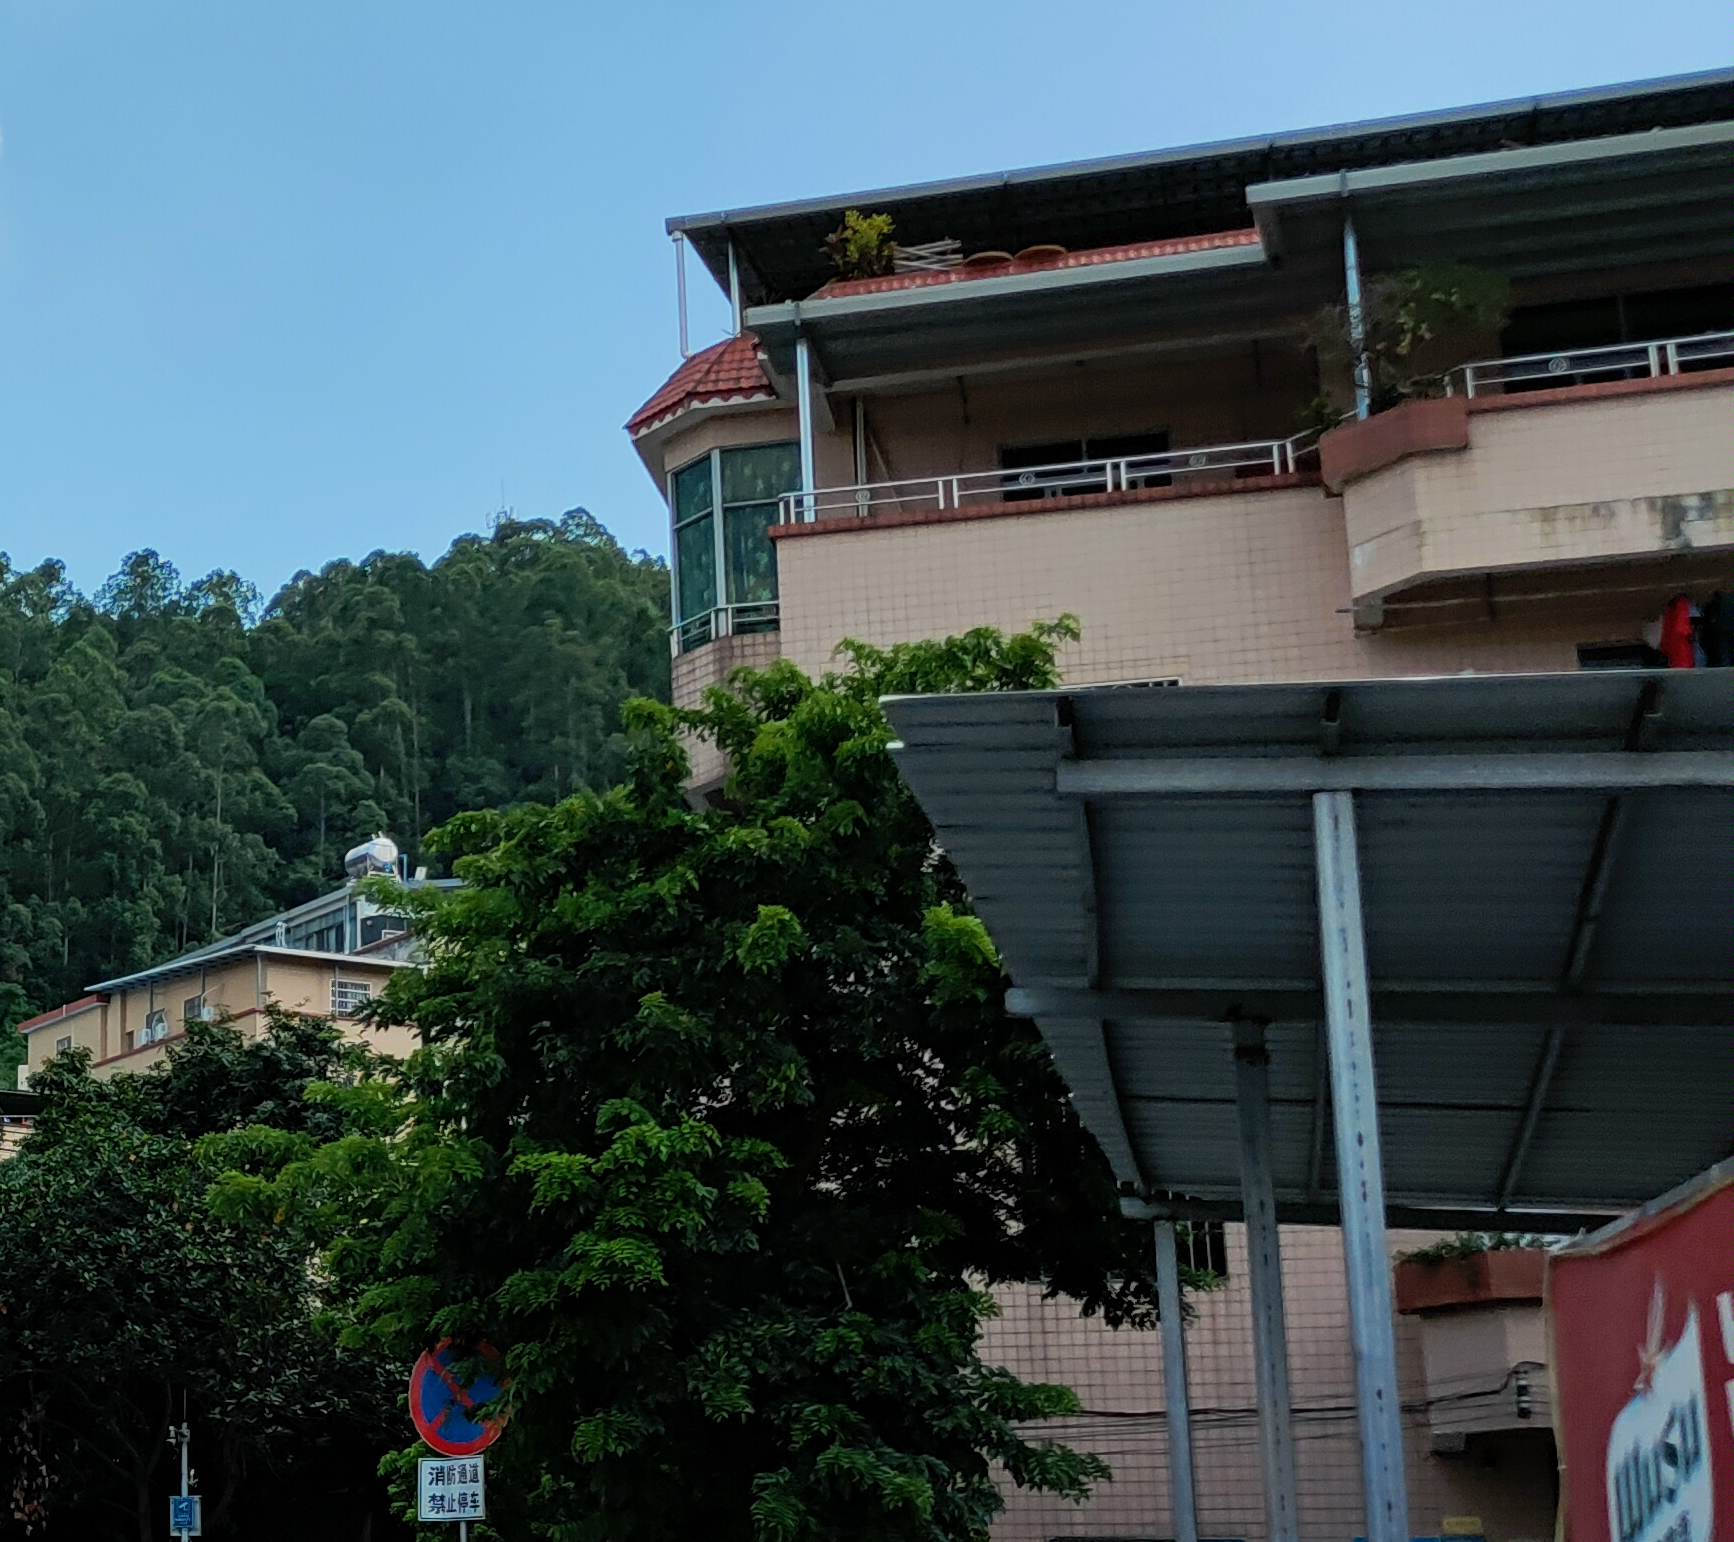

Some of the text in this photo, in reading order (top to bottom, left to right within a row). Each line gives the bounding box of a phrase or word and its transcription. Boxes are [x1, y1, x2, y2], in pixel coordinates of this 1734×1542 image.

[428, 1463, 480, 1487] 消防通道
[428, 1491, 480, 1514] 禁止停车
